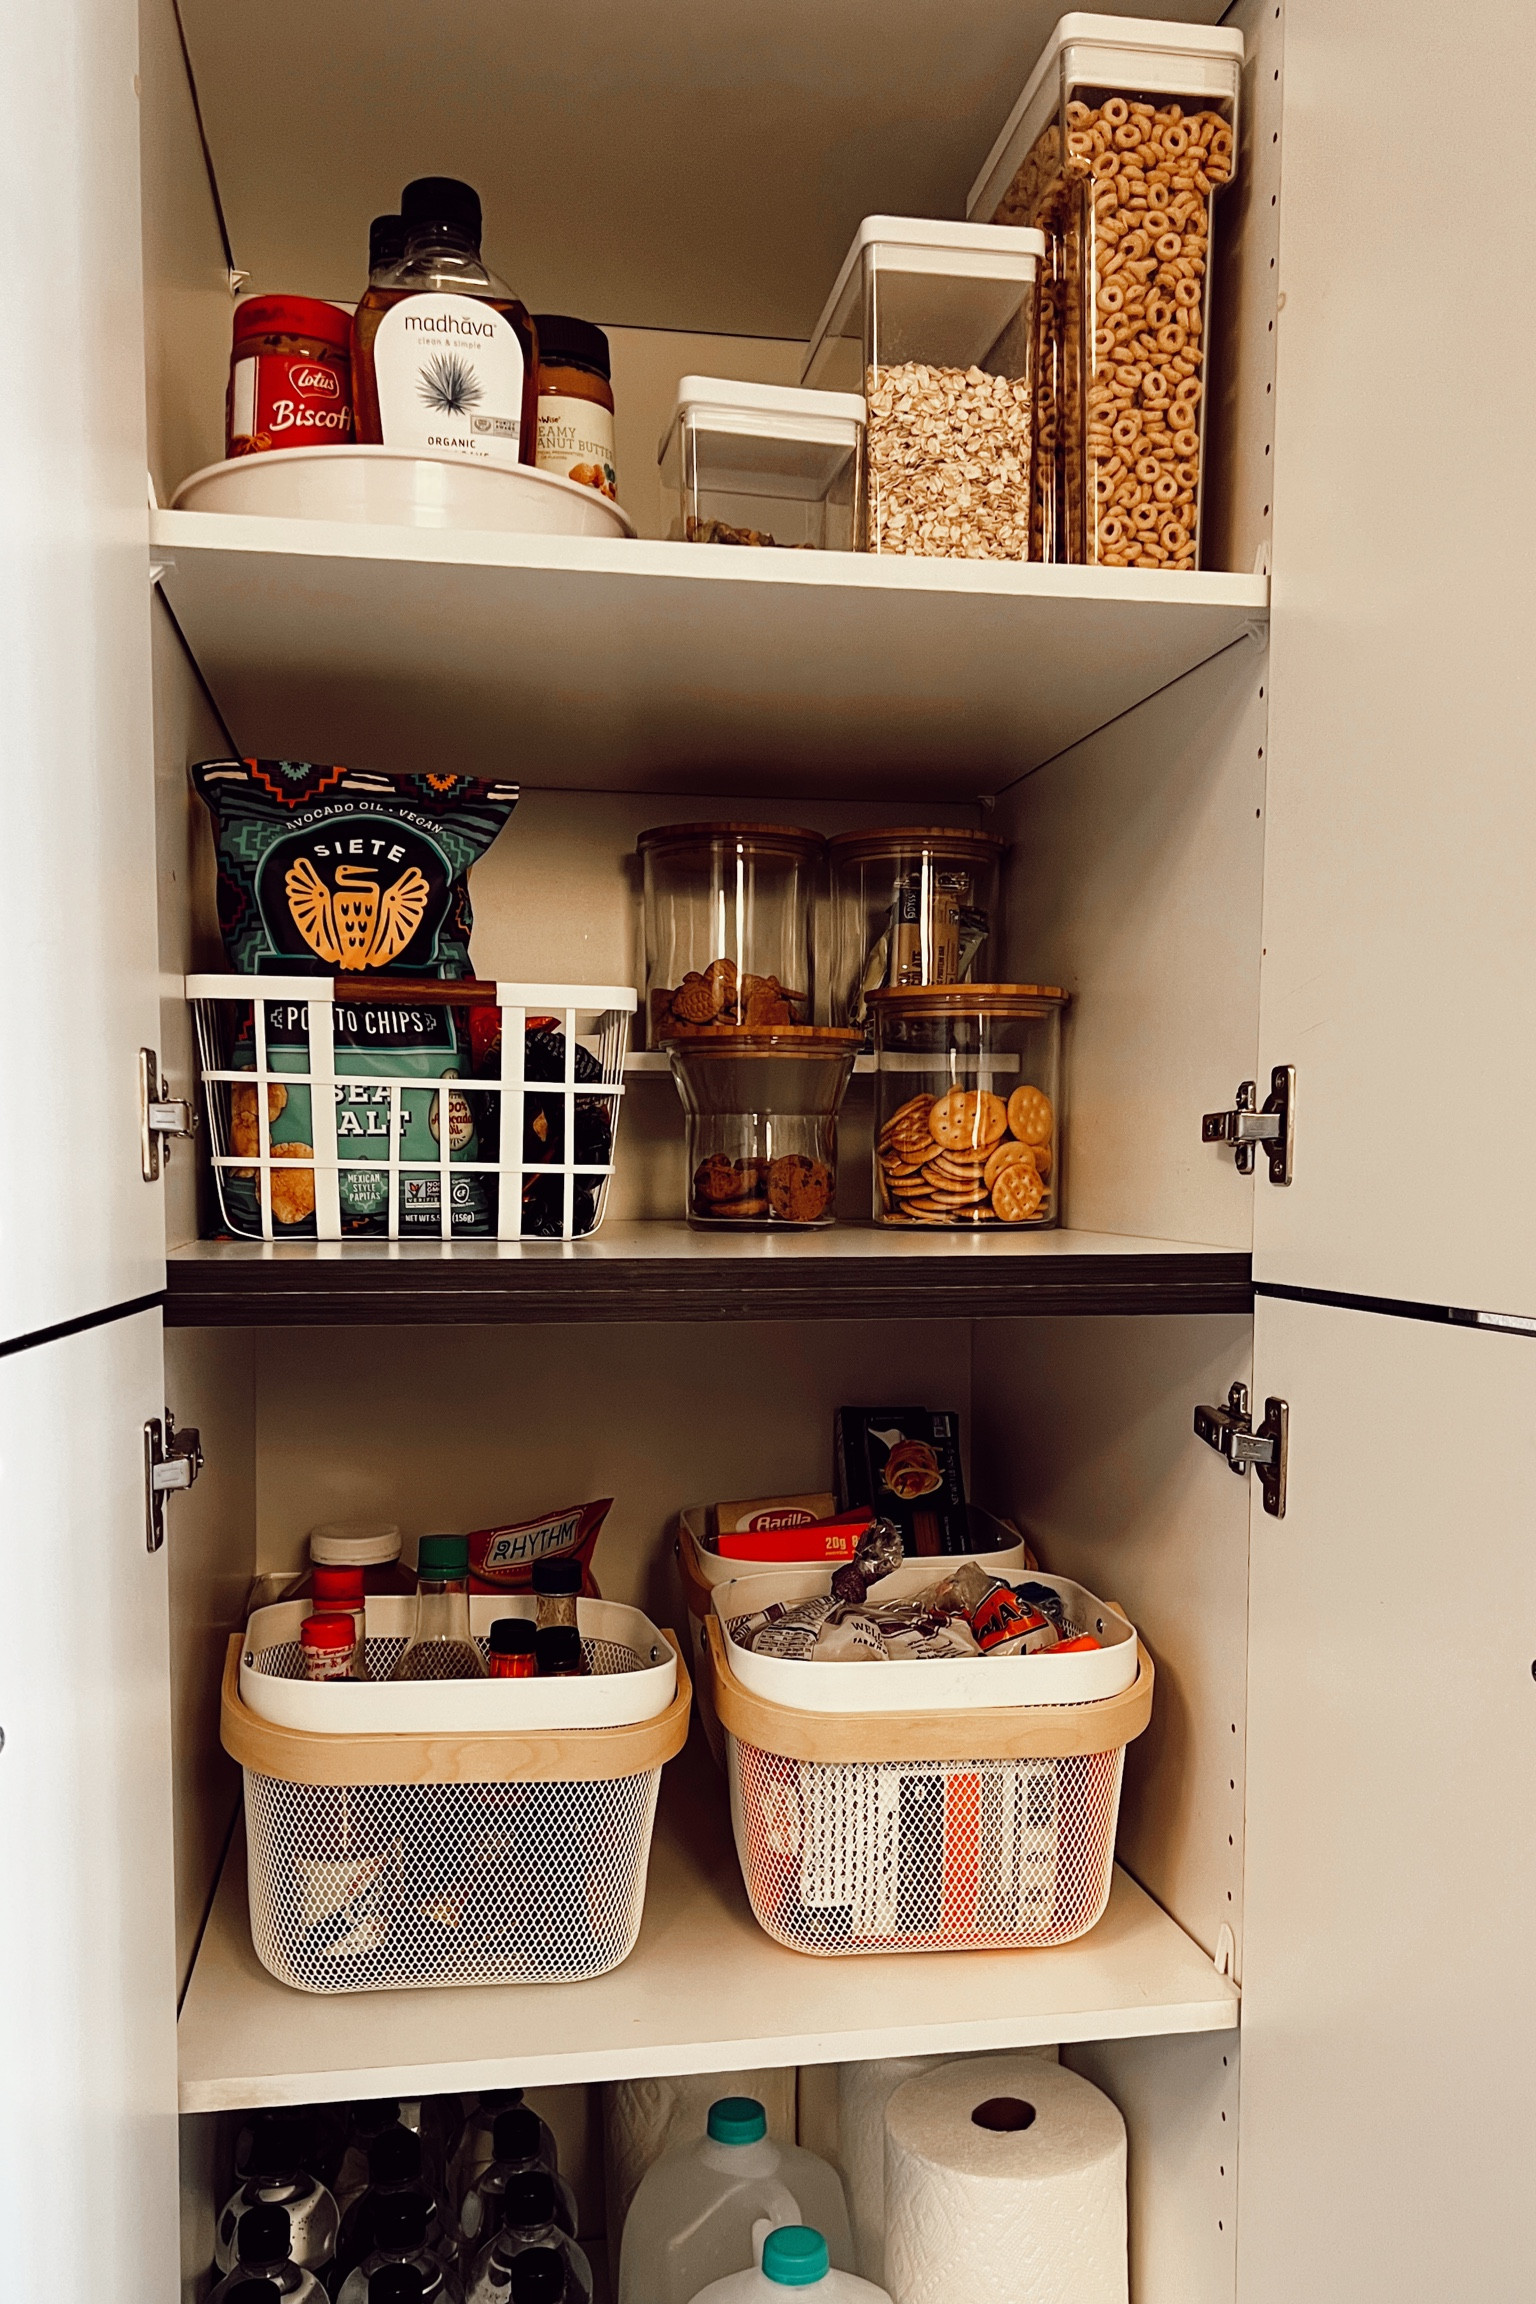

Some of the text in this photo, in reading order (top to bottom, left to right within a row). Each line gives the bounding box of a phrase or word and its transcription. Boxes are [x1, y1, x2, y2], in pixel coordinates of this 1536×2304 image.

[418, 337, 481, 350] clean & simple
[298, 369, 334, 390] Lotus
[538, 426, 576, 439] EAMY
[427, 436, 476, 449] ORGANIC
[537, 438, 574, 450] ANUT
[286, 801, 444, 834] AVOCADO OIL VEGAN
[314, 839, 406, 863] SIETE
[287, 1006, 424, 1035] POTO CHIPS
[448, 1101, 468, 1112] 00%
[337, 1110, 410, 1135] ALT
[347, 1173, 381, 1183] MEXICAN
[352, 1184, 376, 1193] STYLE
[349, 1191, 381, 1202] PAPITAS
[405, 1214, 418, 1222] NET
[418, 1214, 430, 1222] WT
[493, 1519, 578, 1561] RHYTHM
[825, 1536, 847, 1550] 20g
[977, 1597, 1034, 1641] MAS
[851, 1621, 883, 1644] WELL
